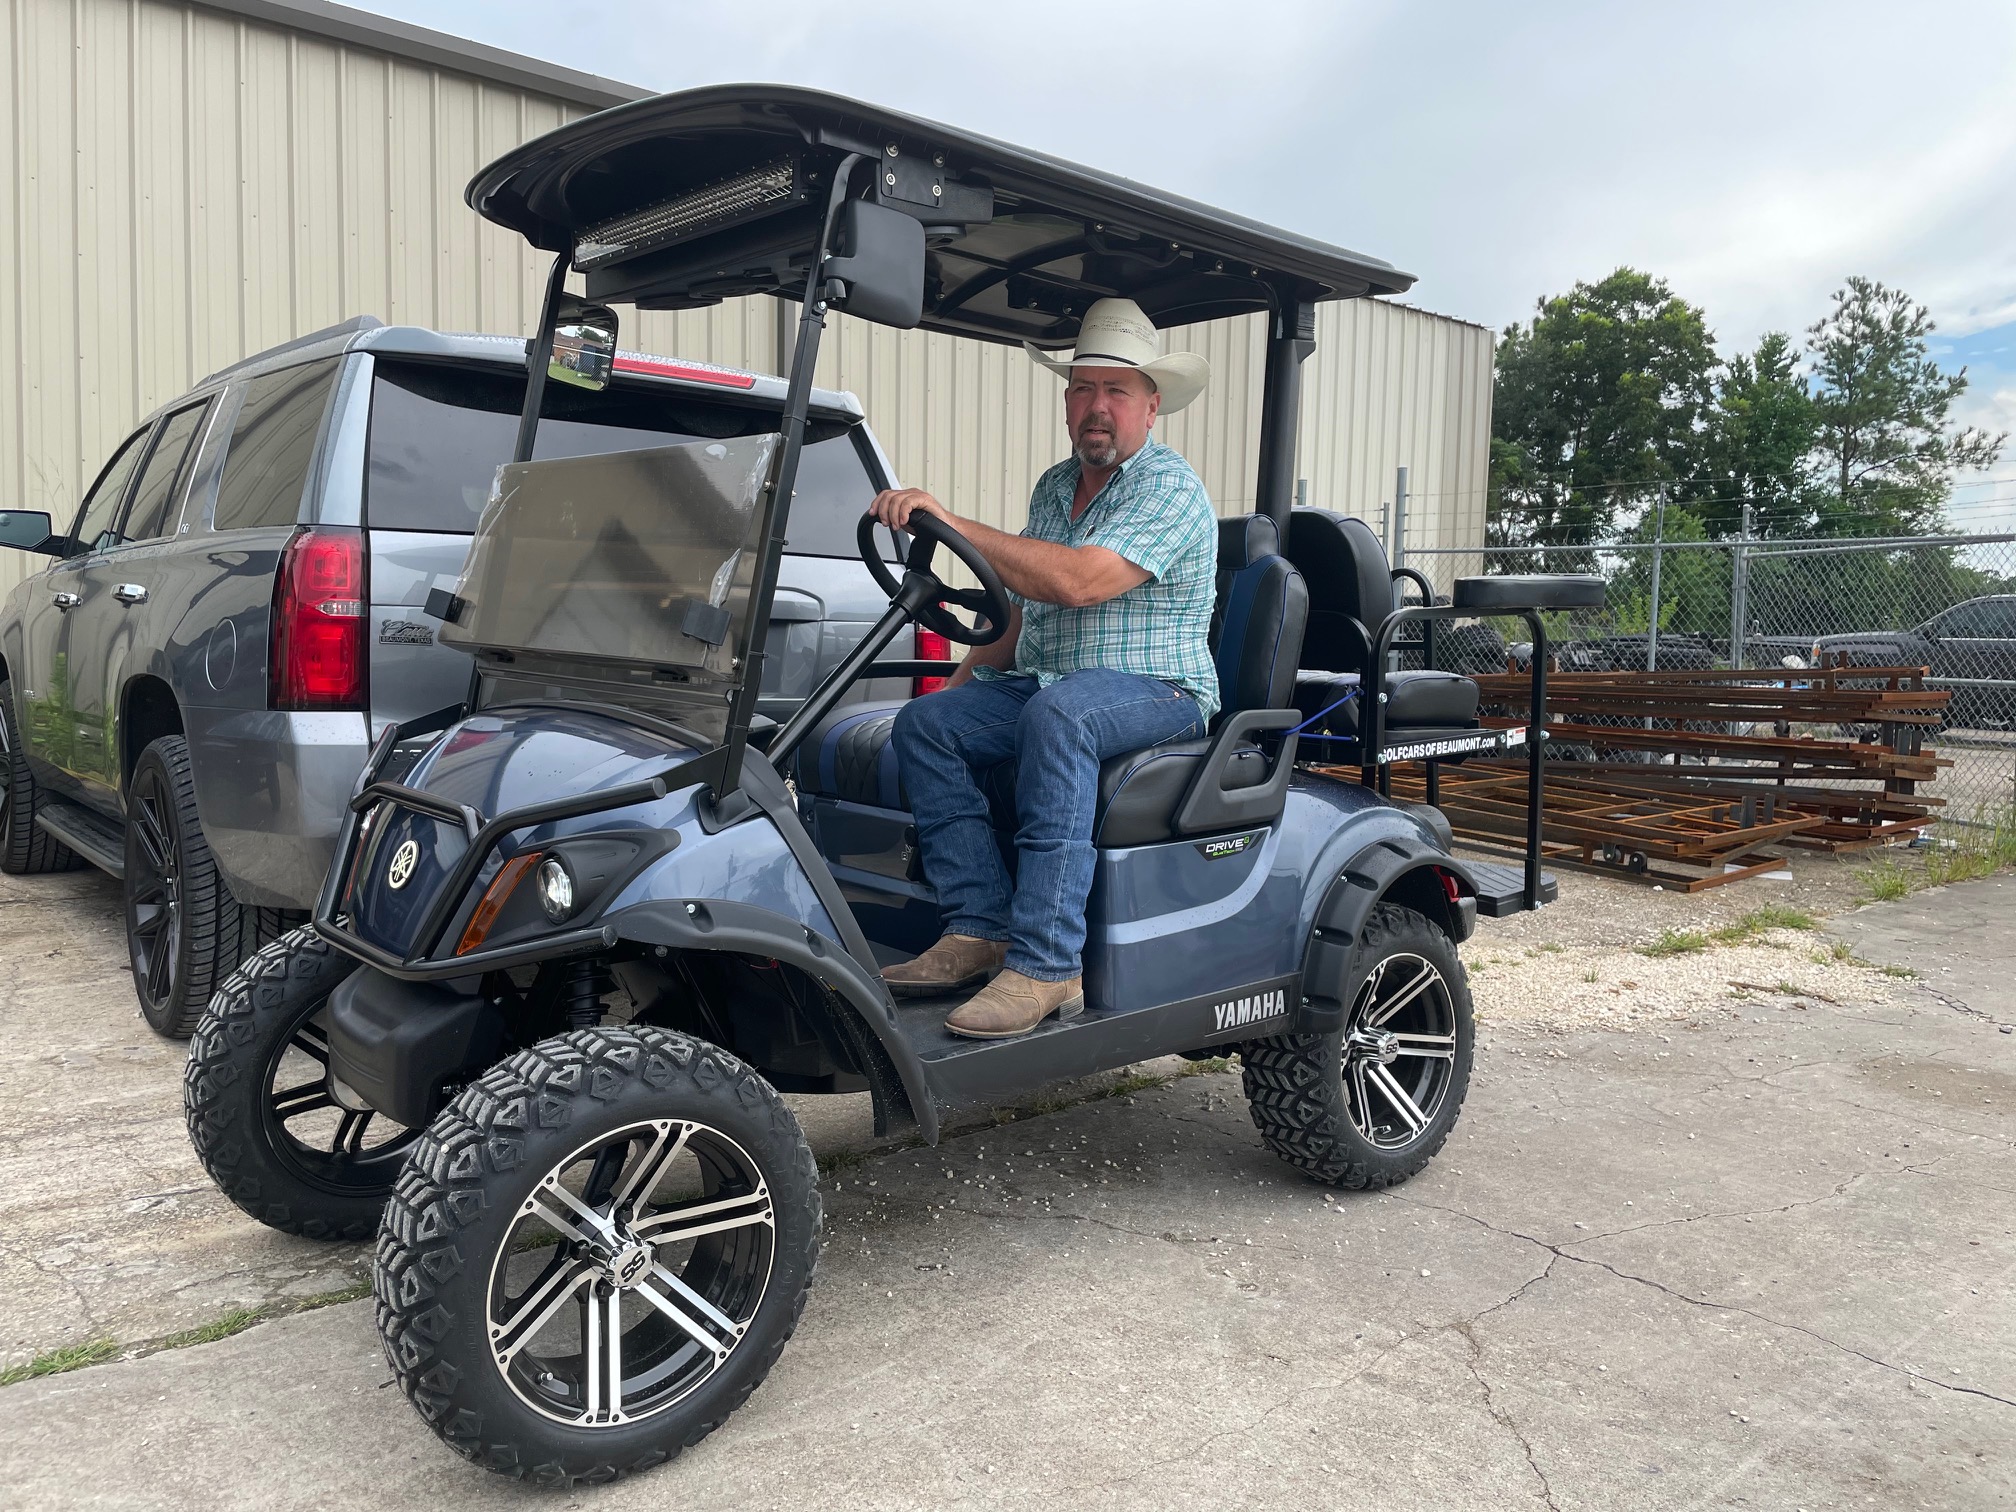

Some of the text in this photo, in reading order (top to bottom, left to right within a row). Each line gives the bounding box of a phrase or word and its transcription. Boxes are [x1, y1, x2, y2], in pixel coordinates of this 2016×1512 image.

[414, 636, 432, 644] TEXAS
[1214, 989, 1285, 1030] YAMAHA
[621, 1250, 646, 1283] SS
